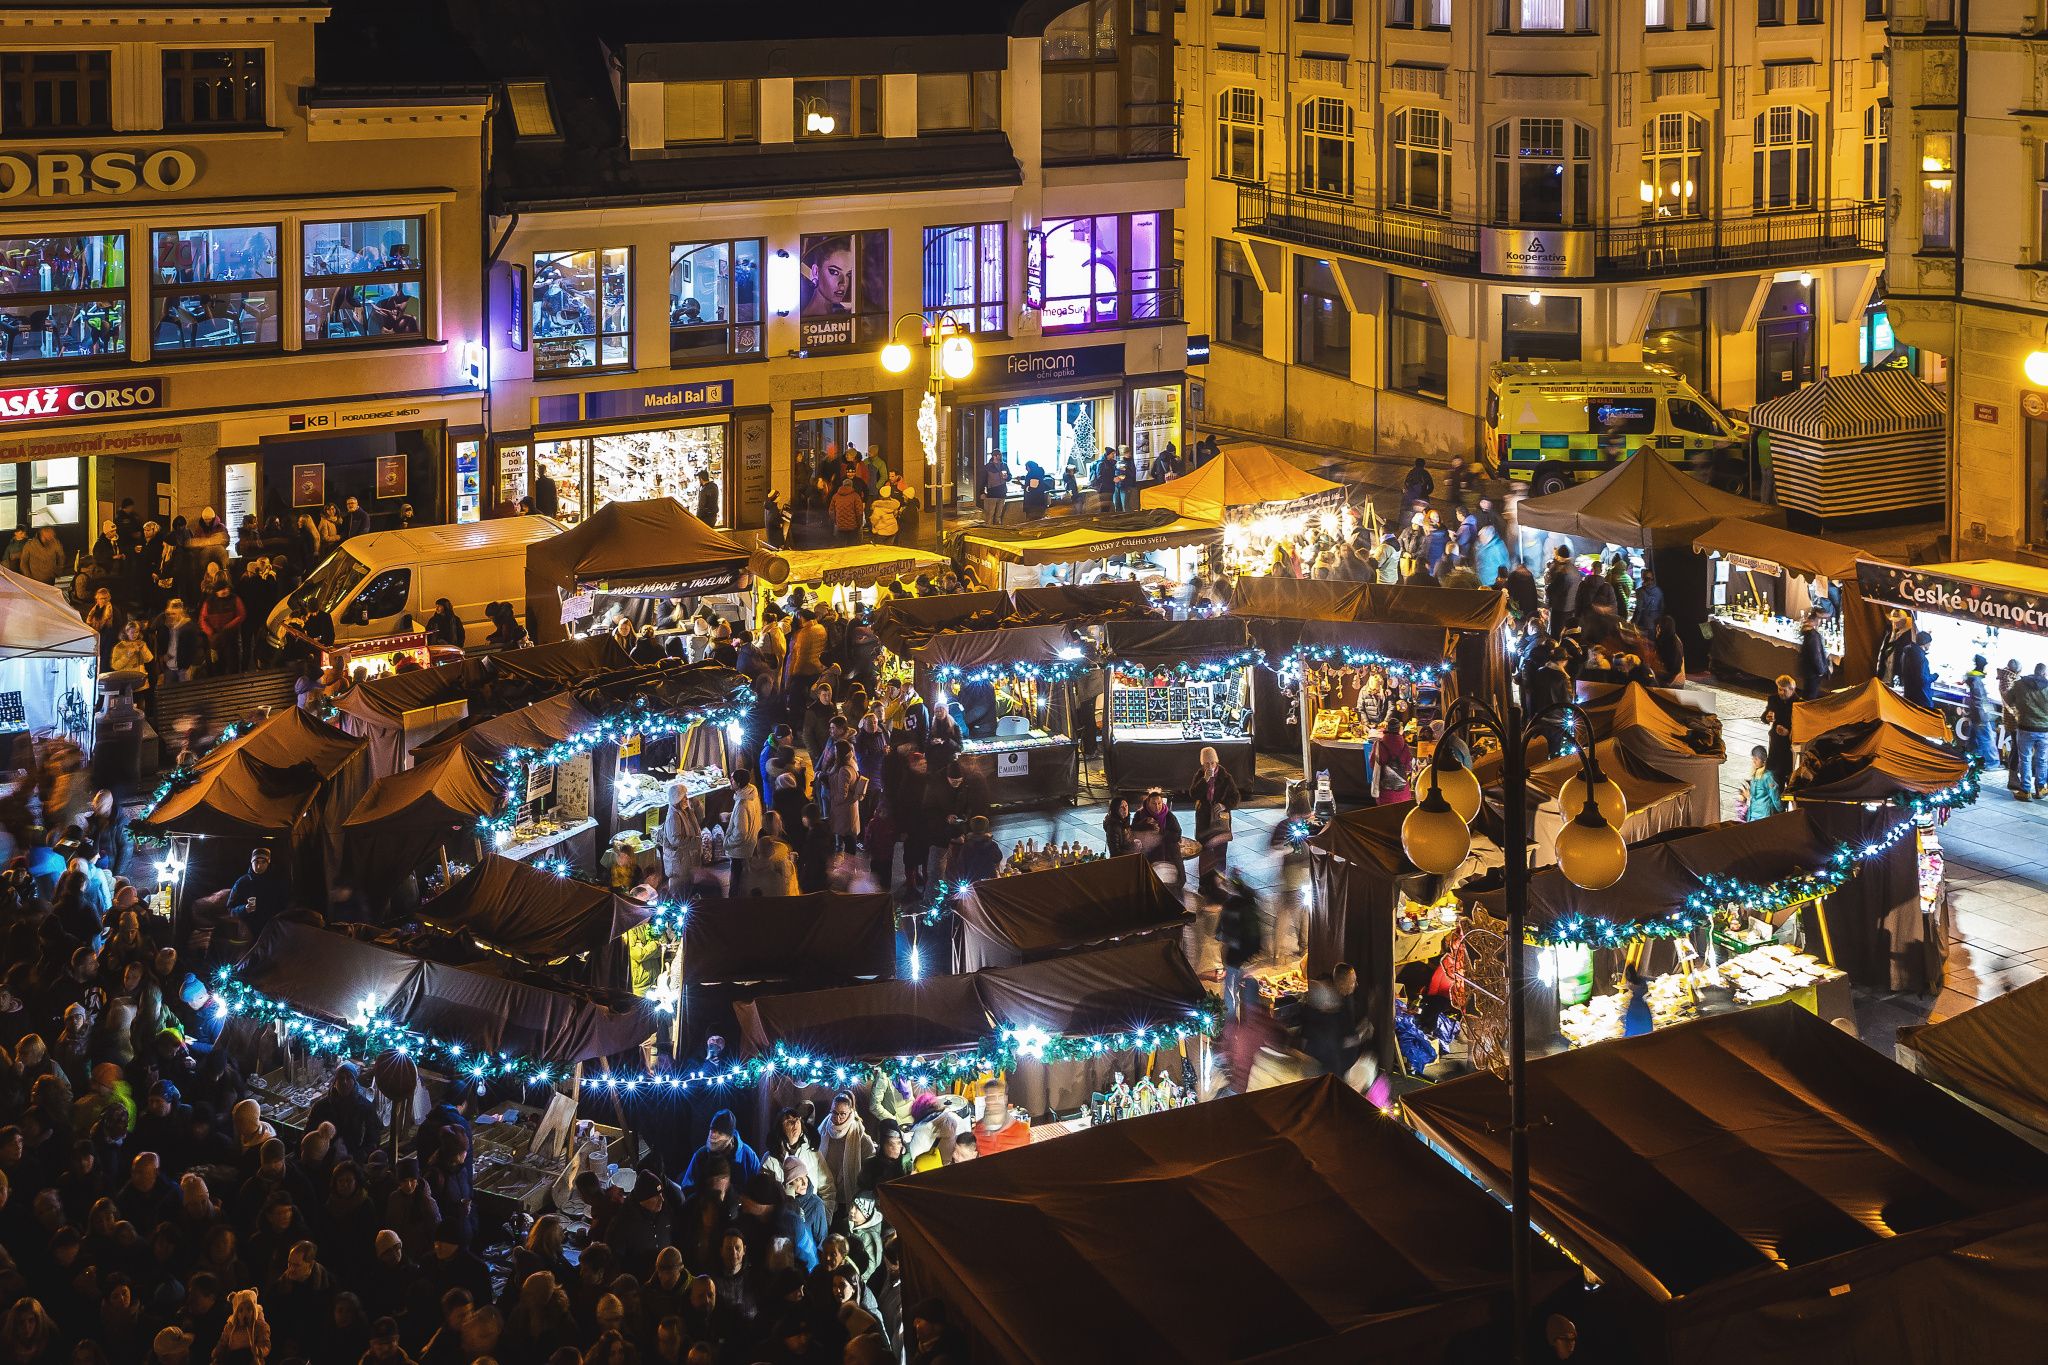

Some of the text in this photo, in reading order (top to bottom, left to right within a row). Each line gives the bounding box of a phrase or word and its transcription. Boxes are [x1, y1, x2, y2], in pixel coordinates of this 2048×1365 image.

[1506, 251, 1567, 262] Kooperativa
[1043, 304, 1086, 317] megaSun
[803, 320, 850, 334] SOLÁRNÍ
[807, 333, 847, 345] STUDIO
[1037, 368, 1075, 379] oční optika
[67, 386, 155, 411] CORSO
[644, 388, 704, 407] Madal Bal
[307, 415, 329, 427] KB
[342, 408, 420, 422] PORADENSKÉ MÍSTO
[29, 437, 103, 457] ZDRAVOTNÍ
[105, 432, 183, 450] POJIŠŤOVNA
[643, 581, 679, 593] NÁPOJE
[689, 574, 734, 589] TRDELNÍK
[1900, 572, 1963, 610] České
